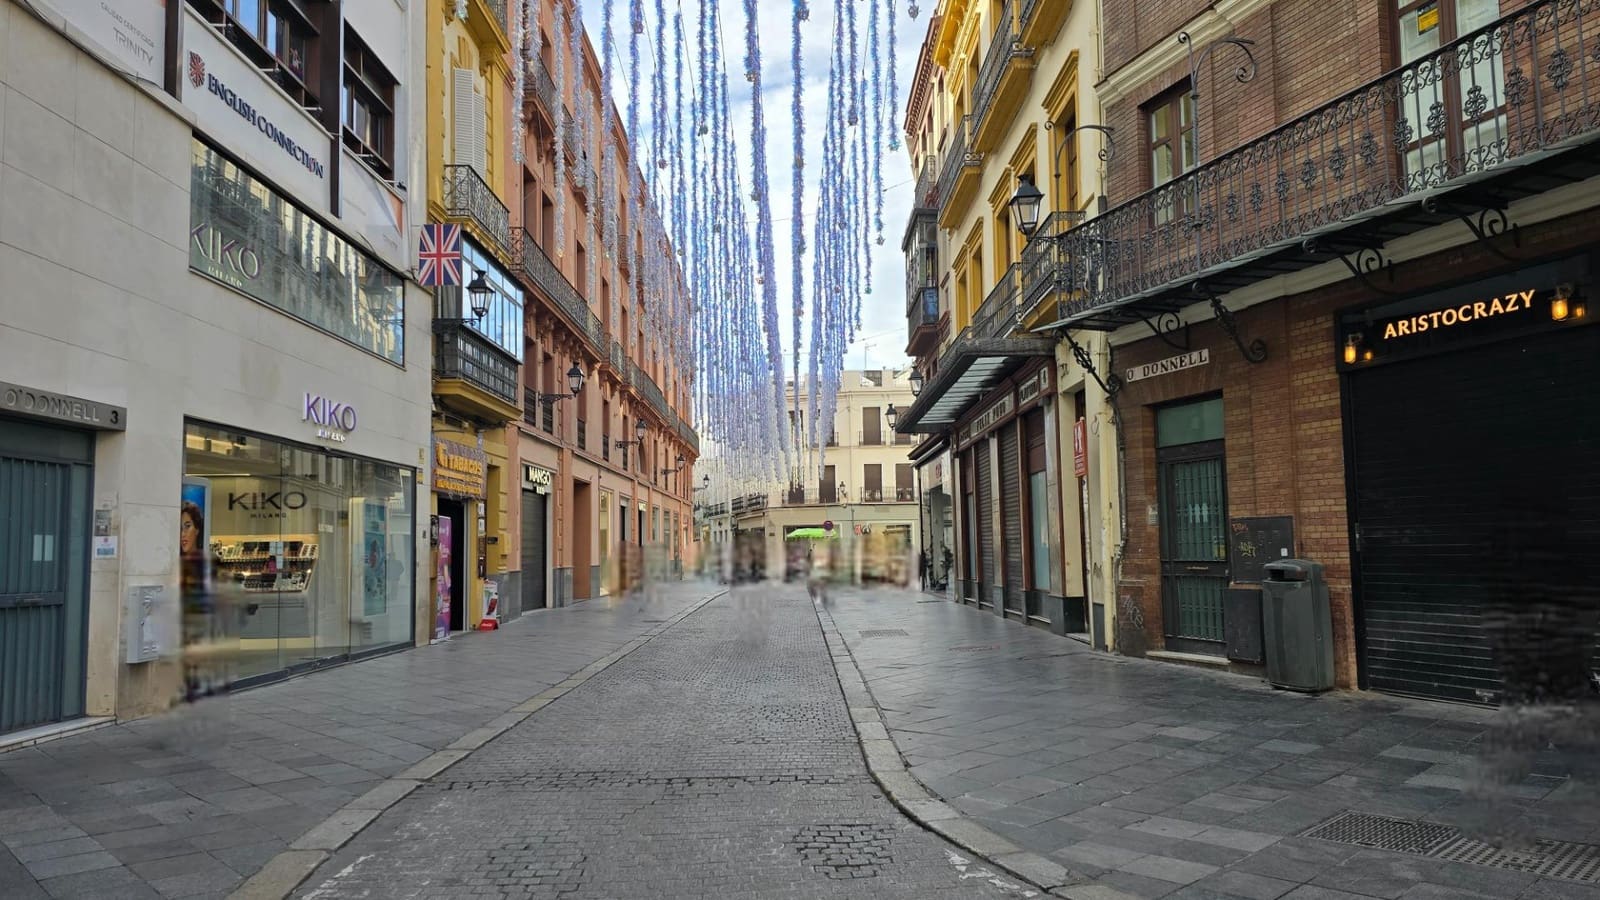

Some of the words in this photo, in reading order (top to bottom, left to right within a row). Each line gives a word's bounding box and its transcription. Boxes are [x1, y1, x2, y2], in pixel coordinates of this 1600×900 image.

[112, 26, 153, 67] TRINITY
[207, 73, 257, 126] ENGLISH
[257, 115, 323, 178] CONNECTION
[1384, 289, 1536, 340] ARISTOCRAZY
[1143, 350, 1207, 377] DONNELL
[110, 410, 119, 424] 3
[304, 392, 357, 432] KIKO
[529, 466, 551, 485] MANGO
[228, 491, 307, 511] KIKO
